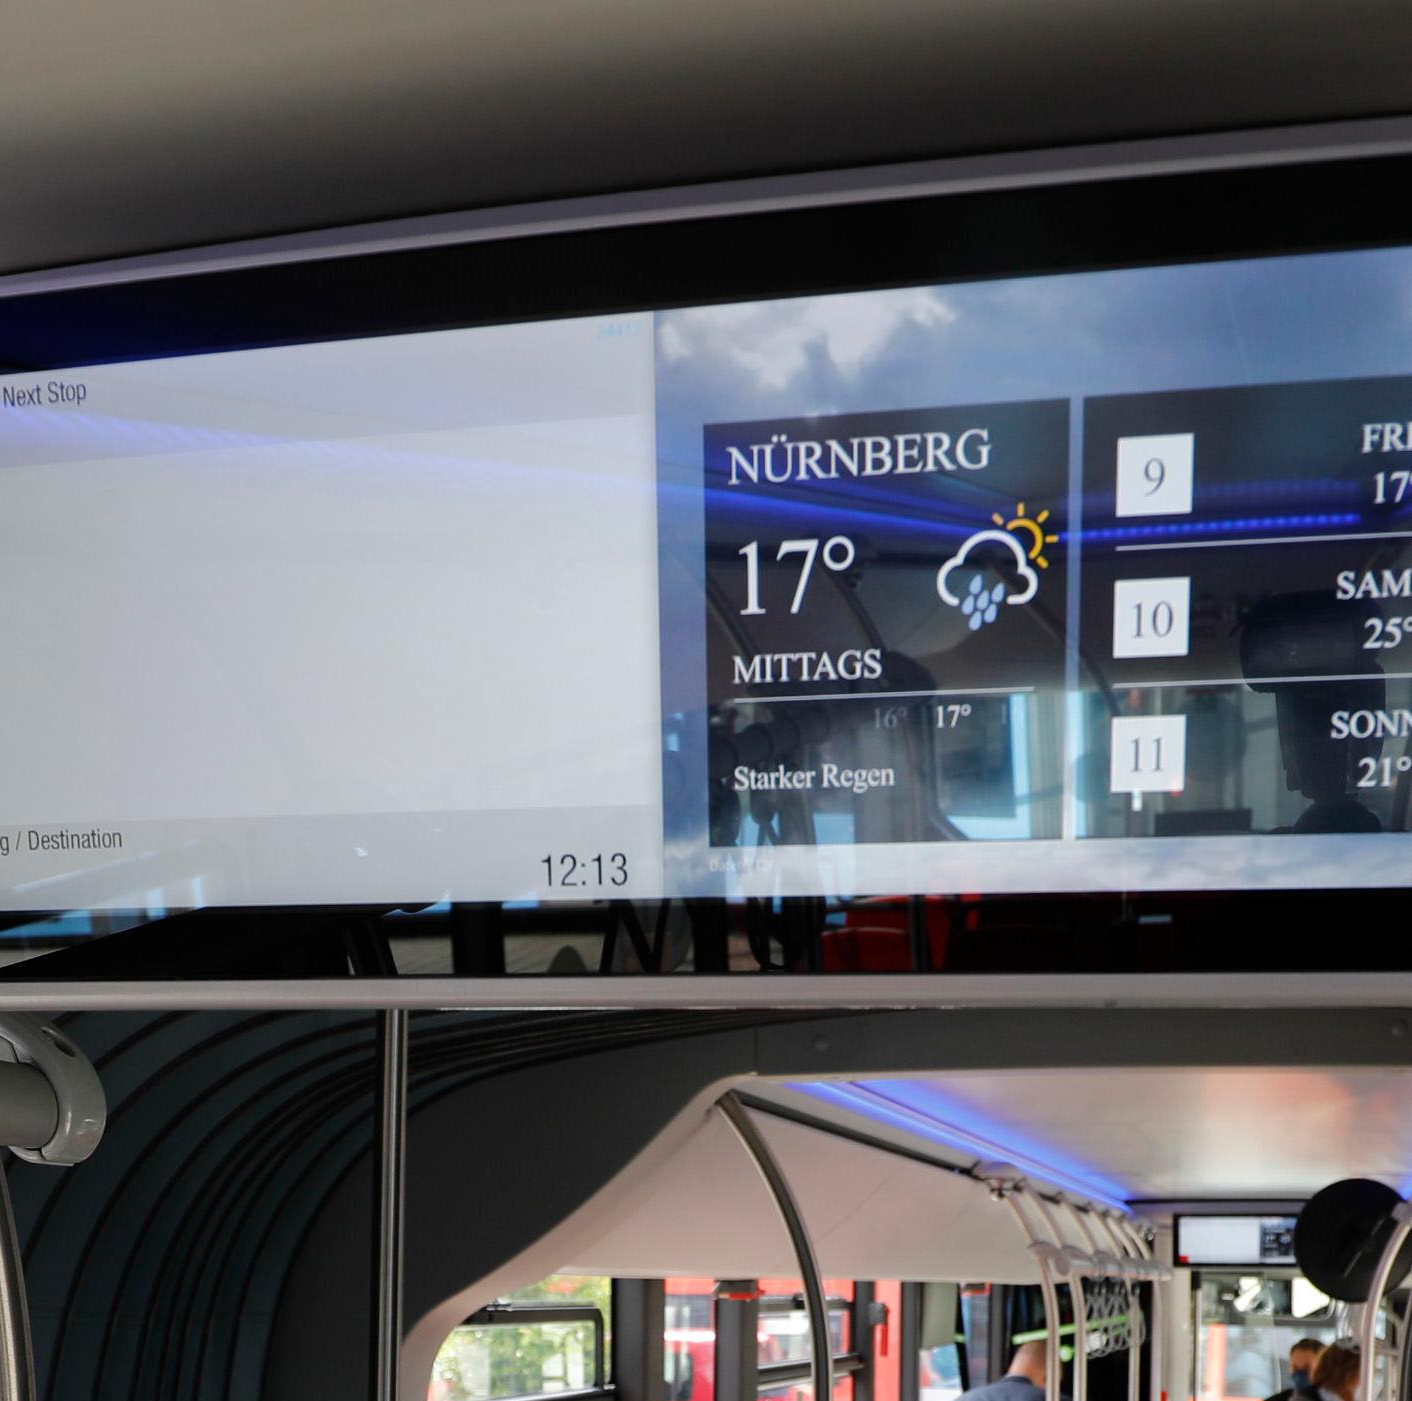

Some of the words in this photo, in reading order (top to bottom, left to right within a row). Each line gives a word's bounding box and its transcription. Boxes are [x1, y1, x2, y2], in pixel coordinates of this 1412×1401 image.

[2, 385, 42, 409] Next
[48, 380, 87, 407] Stop
[726, 428, 992, 485] NÜRNBERG
[1144, 458, 1166, 497] 9
[738, 534, 855, 616] 17°
[1131, 600, 1174, 639] 10
[732, 648, 883, 684] MITTAGS
[935, 703, 972, 730] 17°
[1129, 735, 1165, 773] 11
[1357, 754, 1412, 788] 21°
[733, 763, 816, 792] Starker
[821, 762, 895, 793] Regen
[16, 831, 22, 851] /
[28, 828, 123, 850] Destination
[540, 852, 630, 888] 12:13
